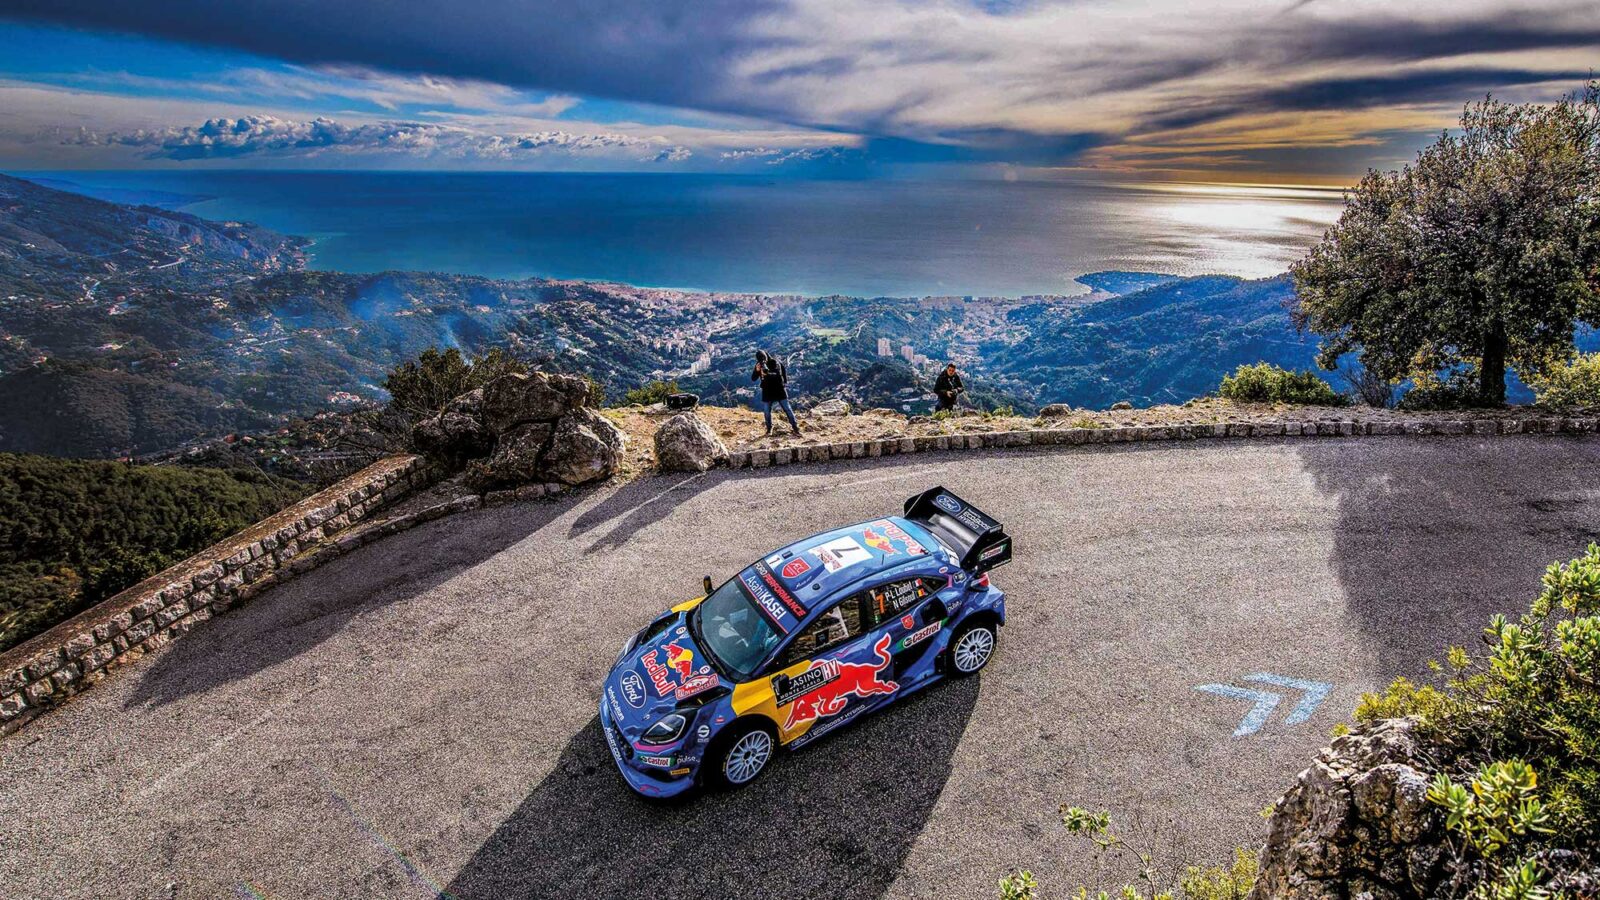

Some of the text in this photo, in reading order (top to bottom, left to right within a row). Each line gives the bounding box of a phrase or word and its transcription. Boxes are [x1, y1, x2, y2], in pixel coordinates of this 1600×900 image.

[831, 546, 860, 559] 7
[754, 561, 768, 576] FORD
[763, 572, 807, 617] PERFORMANCE
[875, 592, 886, 614] 7
[892, 600, 899, 610] N
[912, 622, 939, 642] Castrol
[822, 660, 838, 680] HY
[622, 674, 643, 703] Ford
[844, 704, 866, 718] HYBRID
[647, 757, 669, 766] Castrol
[677, 755, 696, 765] pulse
